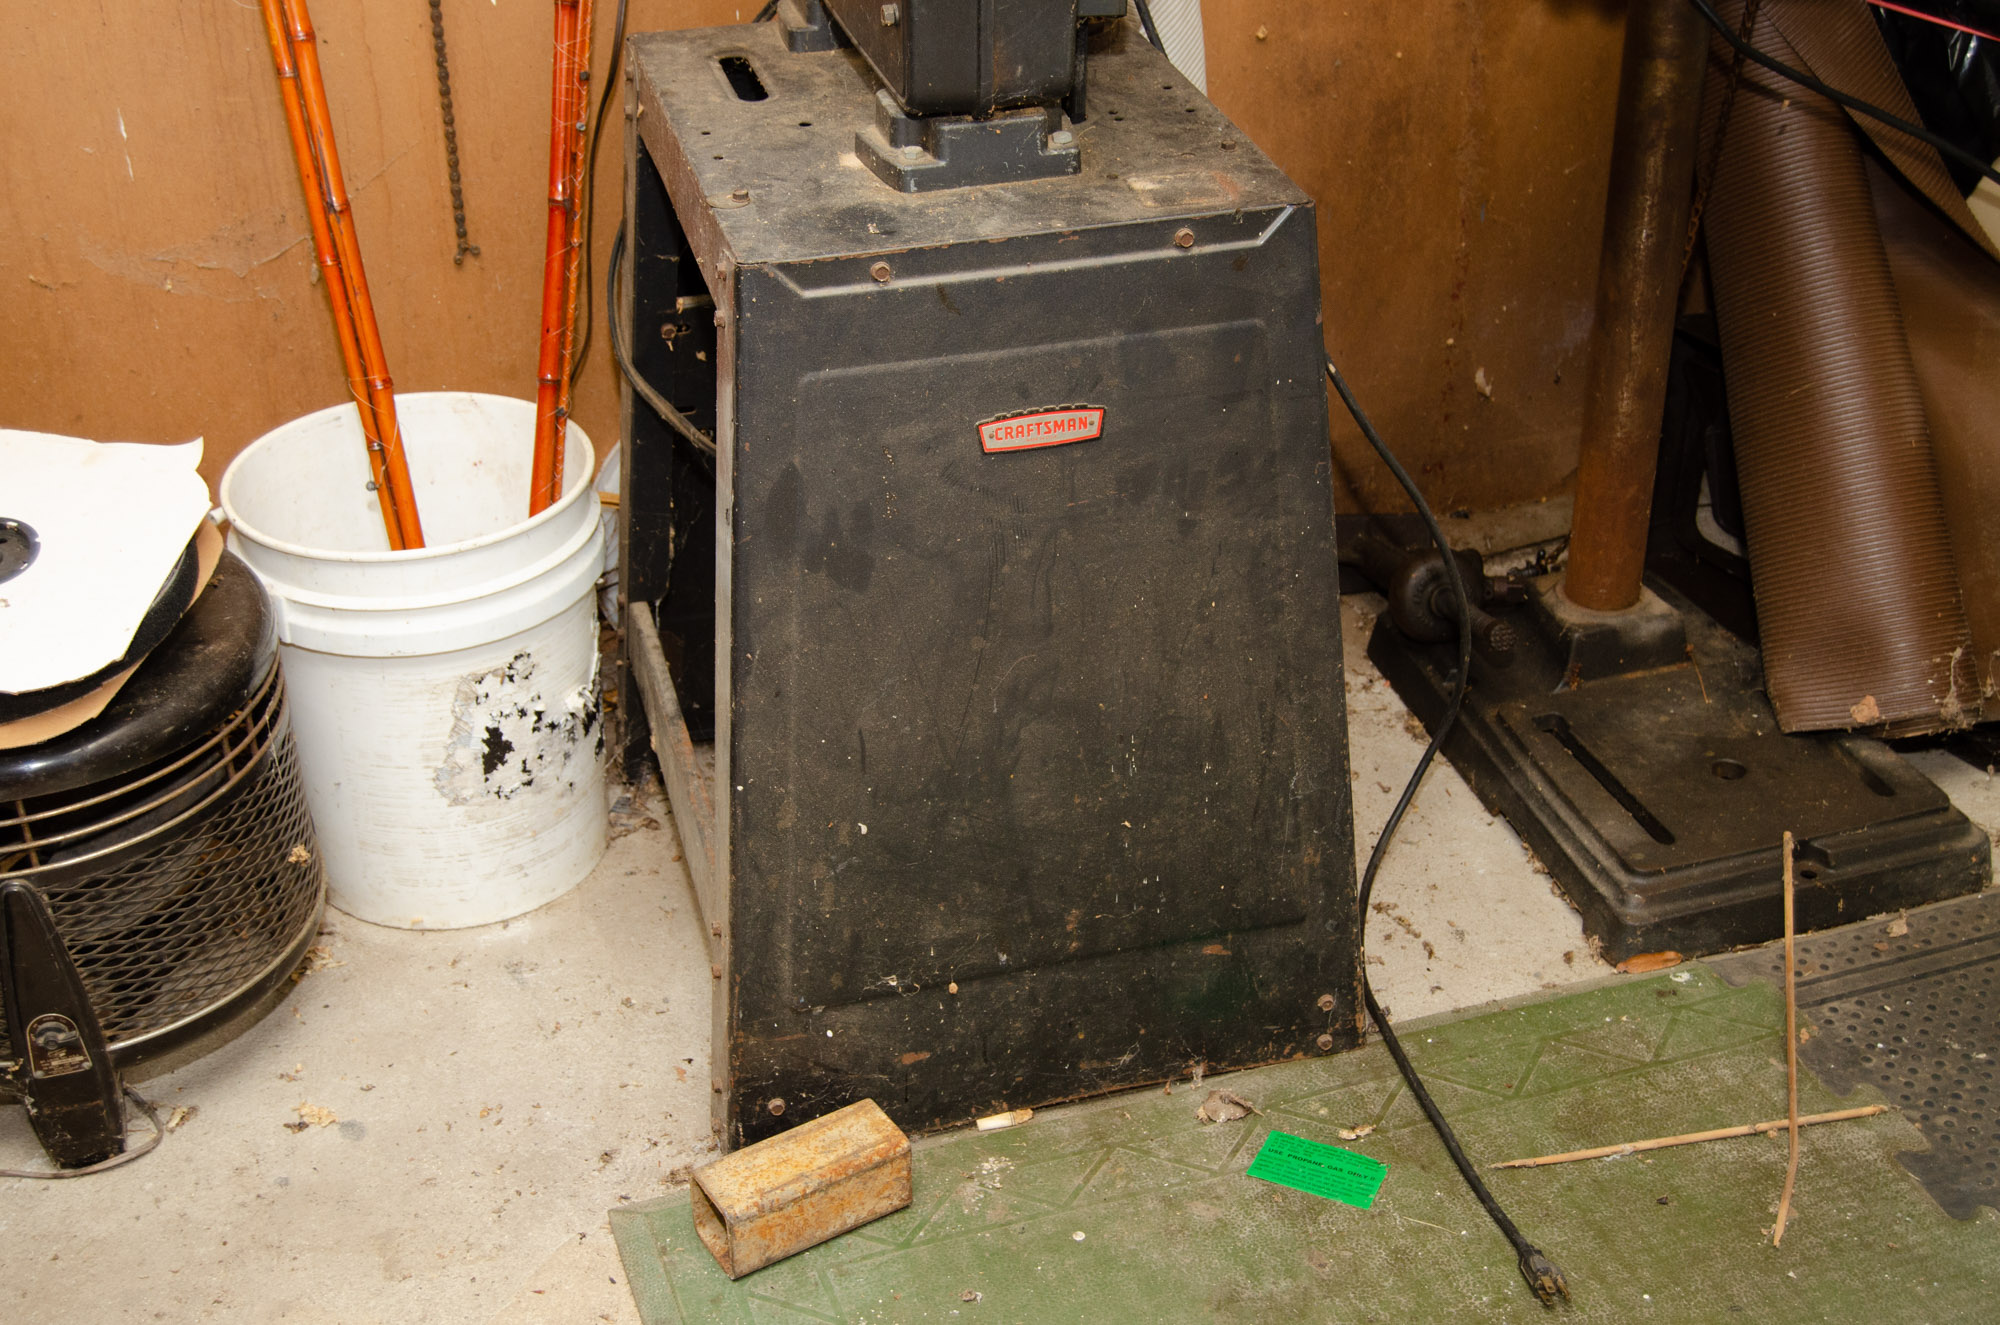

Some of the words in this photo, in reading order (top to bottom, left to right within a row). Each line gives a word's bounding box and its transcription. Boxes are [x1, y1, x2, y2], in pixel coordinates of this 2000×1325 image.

[994, 416, 1088, 441] CRAFTSMAN
[1268, 1148, 1283, 1156] USE
[1287, 1153, 1323, 1167] PROPANE
[1327, 1164, 1344, 1172] GAS
[1347, 1169, 1368, 1179] ONLY
